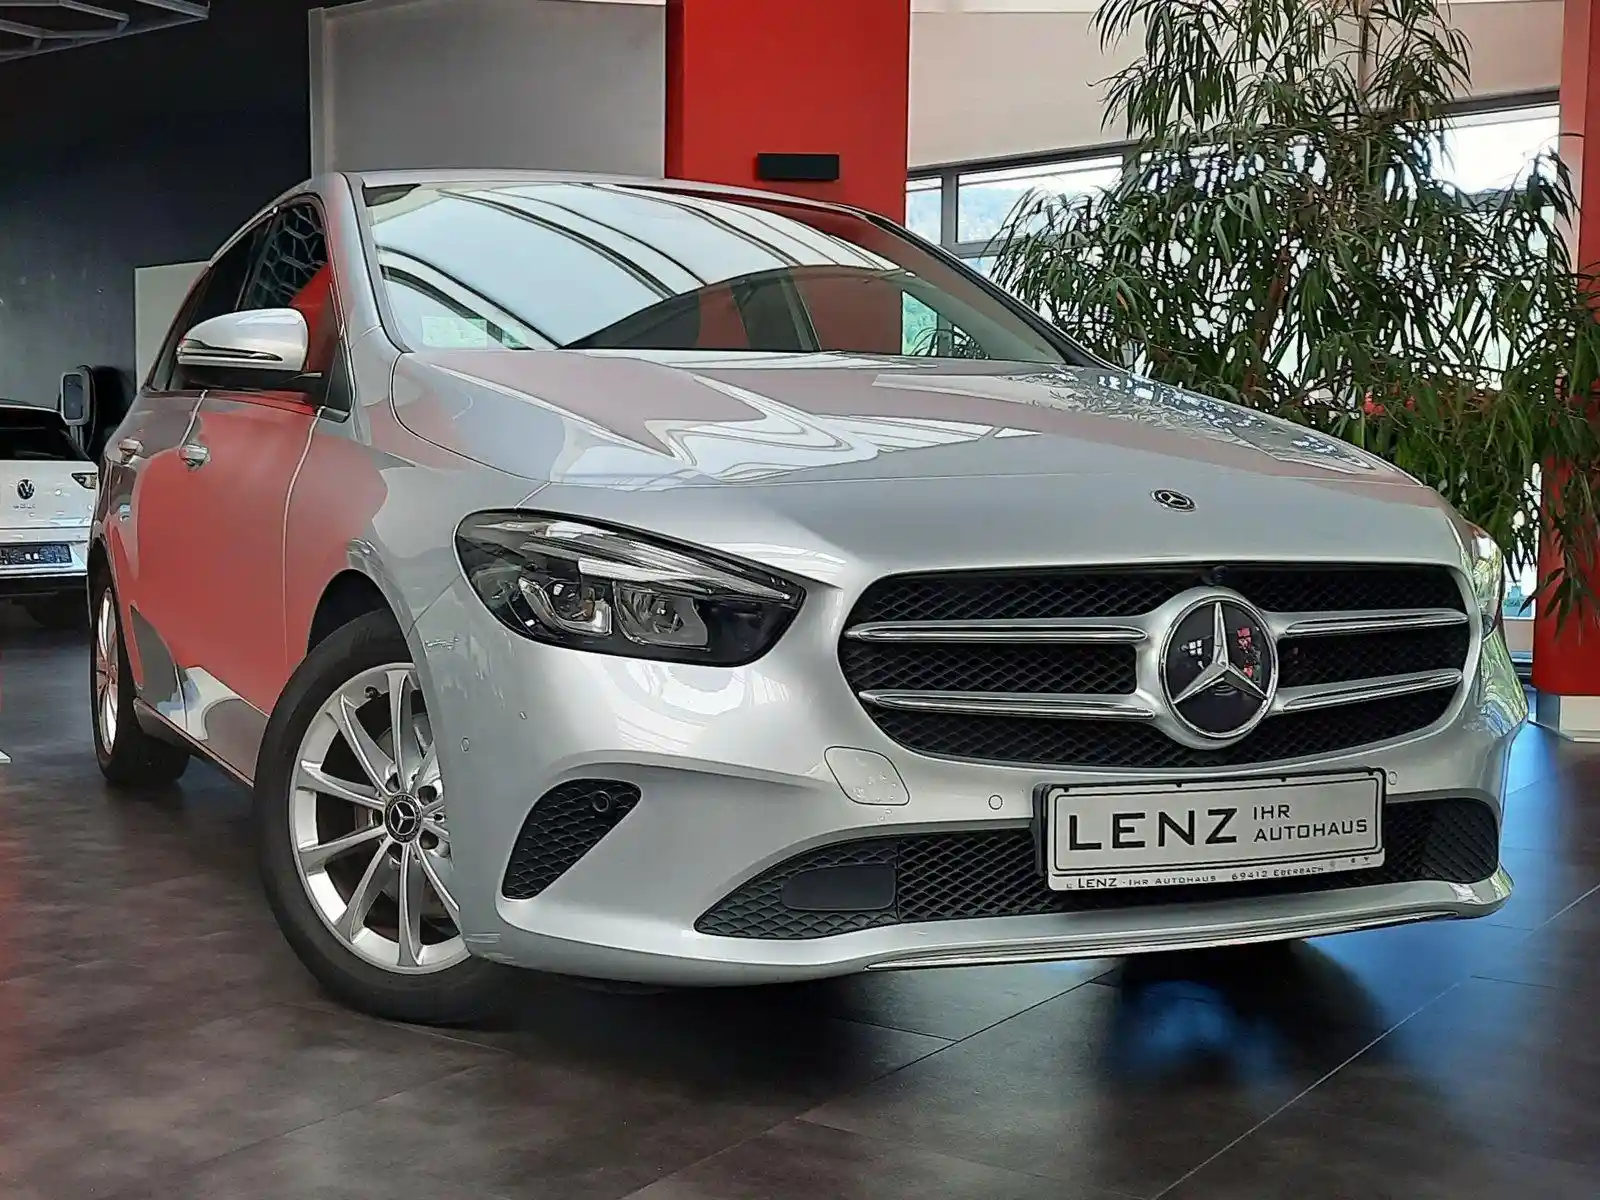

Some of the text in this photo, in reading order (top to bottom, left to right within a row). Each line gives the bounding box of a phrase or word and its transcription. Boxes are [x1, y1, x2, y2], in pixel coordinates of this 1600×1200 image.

[1253, 804, 1290, 821] IHR
[1068, 808, 1238, 851] LENZ
[1253, 819, 1368, 843] AUTOHAUS
[1078, 877, 1117, 889] LENZ
[1155, 875, 1217, 885] AUTOHAUS
[1231, 871, 1268, 880] 69412
[1273, 866, 1324, 877] EBERBACH
